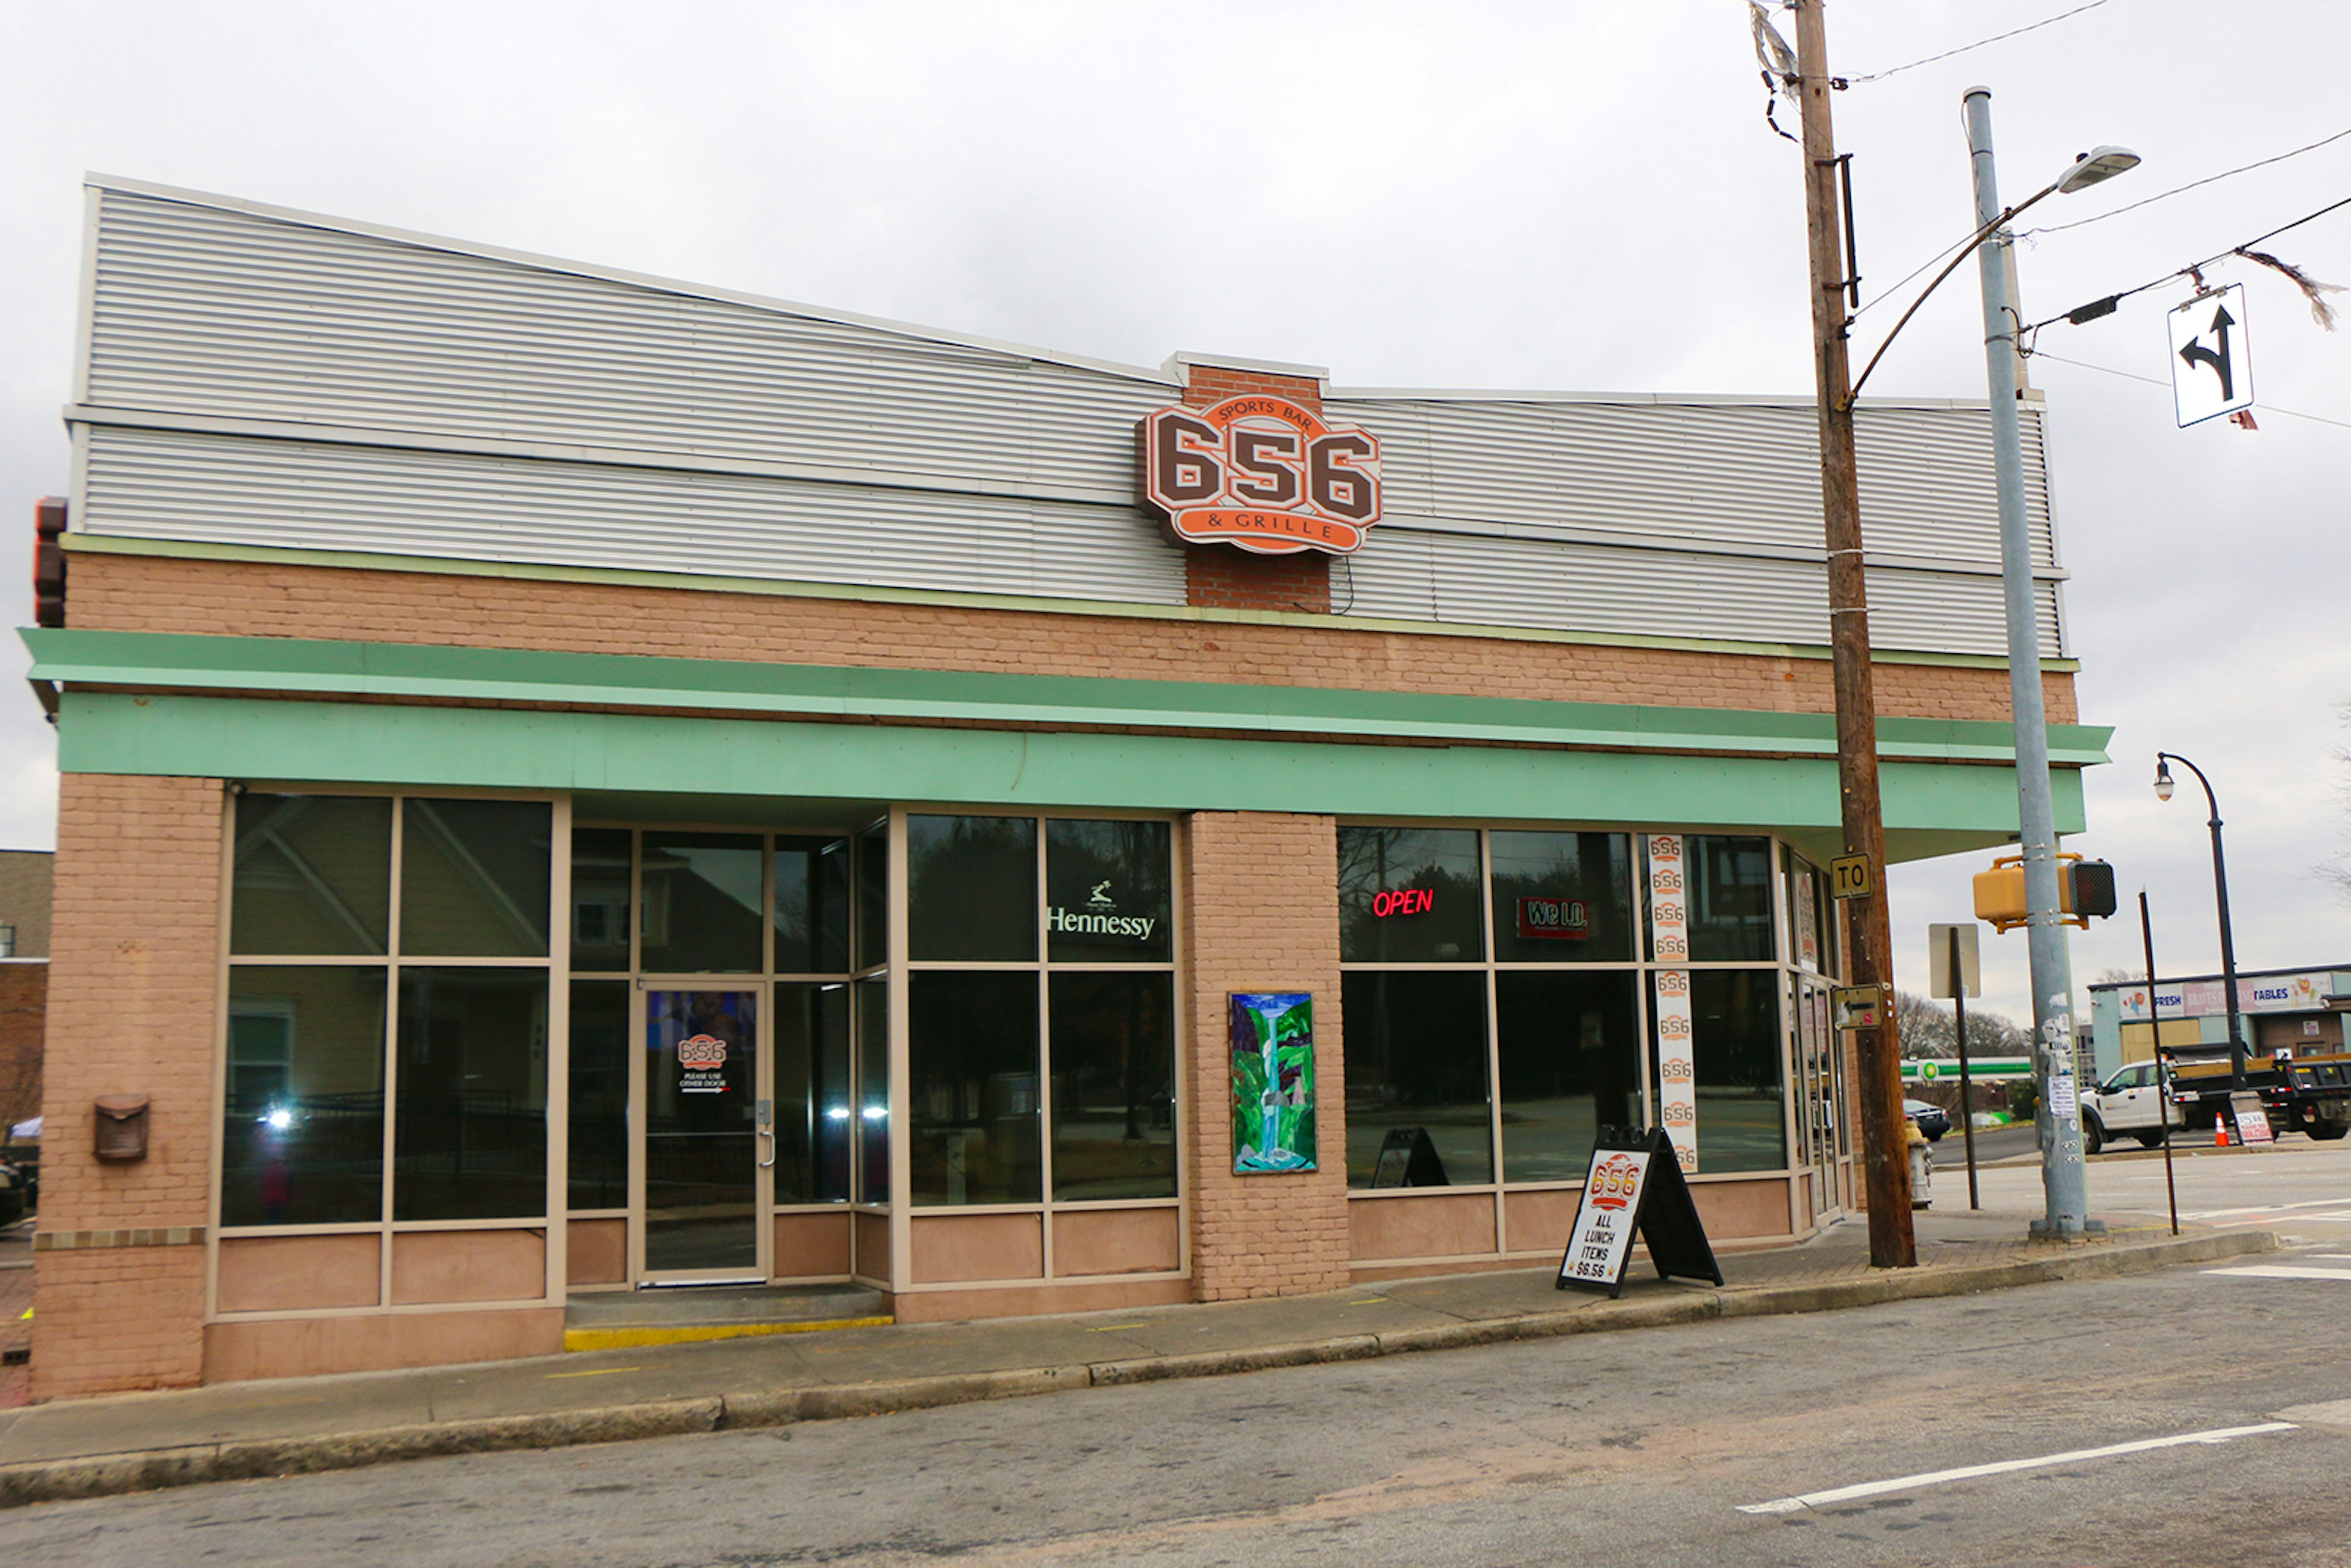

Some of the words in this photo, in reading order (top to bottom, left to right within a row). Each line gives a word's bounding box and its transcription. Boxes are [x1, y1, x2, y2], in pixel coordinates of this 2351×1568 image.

[1218, 400, 1275, 421] SPORTS
[1283, 407, 1313, 430] BAR
[1156, 413, 1374, 520] 656
[1208, 512, 1223, 527] &
[1235, 514, 1332, 538] GRILLE
[1651, 842, 1680, 855] 656
[1652, 874, 1682, 888] 656
[1838, 865, 1864, 888] TO
[1373, 888, 1434, 917] OPEN
[1654, 907, 1684, 921] 656
[1046, 906, 1155, 940] Hennessy
[1656, 940, 1685, 954] 656
[1658, 977, 1687, 991] 656
[2155, 996, 2181, 1007] FRESH
[1660, 1019, 1690, 1035] 656
[681, 1043, 724, 1060] 656
[1662, 1063, 1692, 1078] 656
[1663, 1106, 1693, 1121] 656
[1591, 1164, 1640, 1197] 656
[1596, 1215, 1611, 1228] ALL
[1584, 1229, 1615, 1245] LUNCH
[1581, 1245, 1609, 1261] ITEMS
[1577, 1261, 1605, 1277] $6.56
